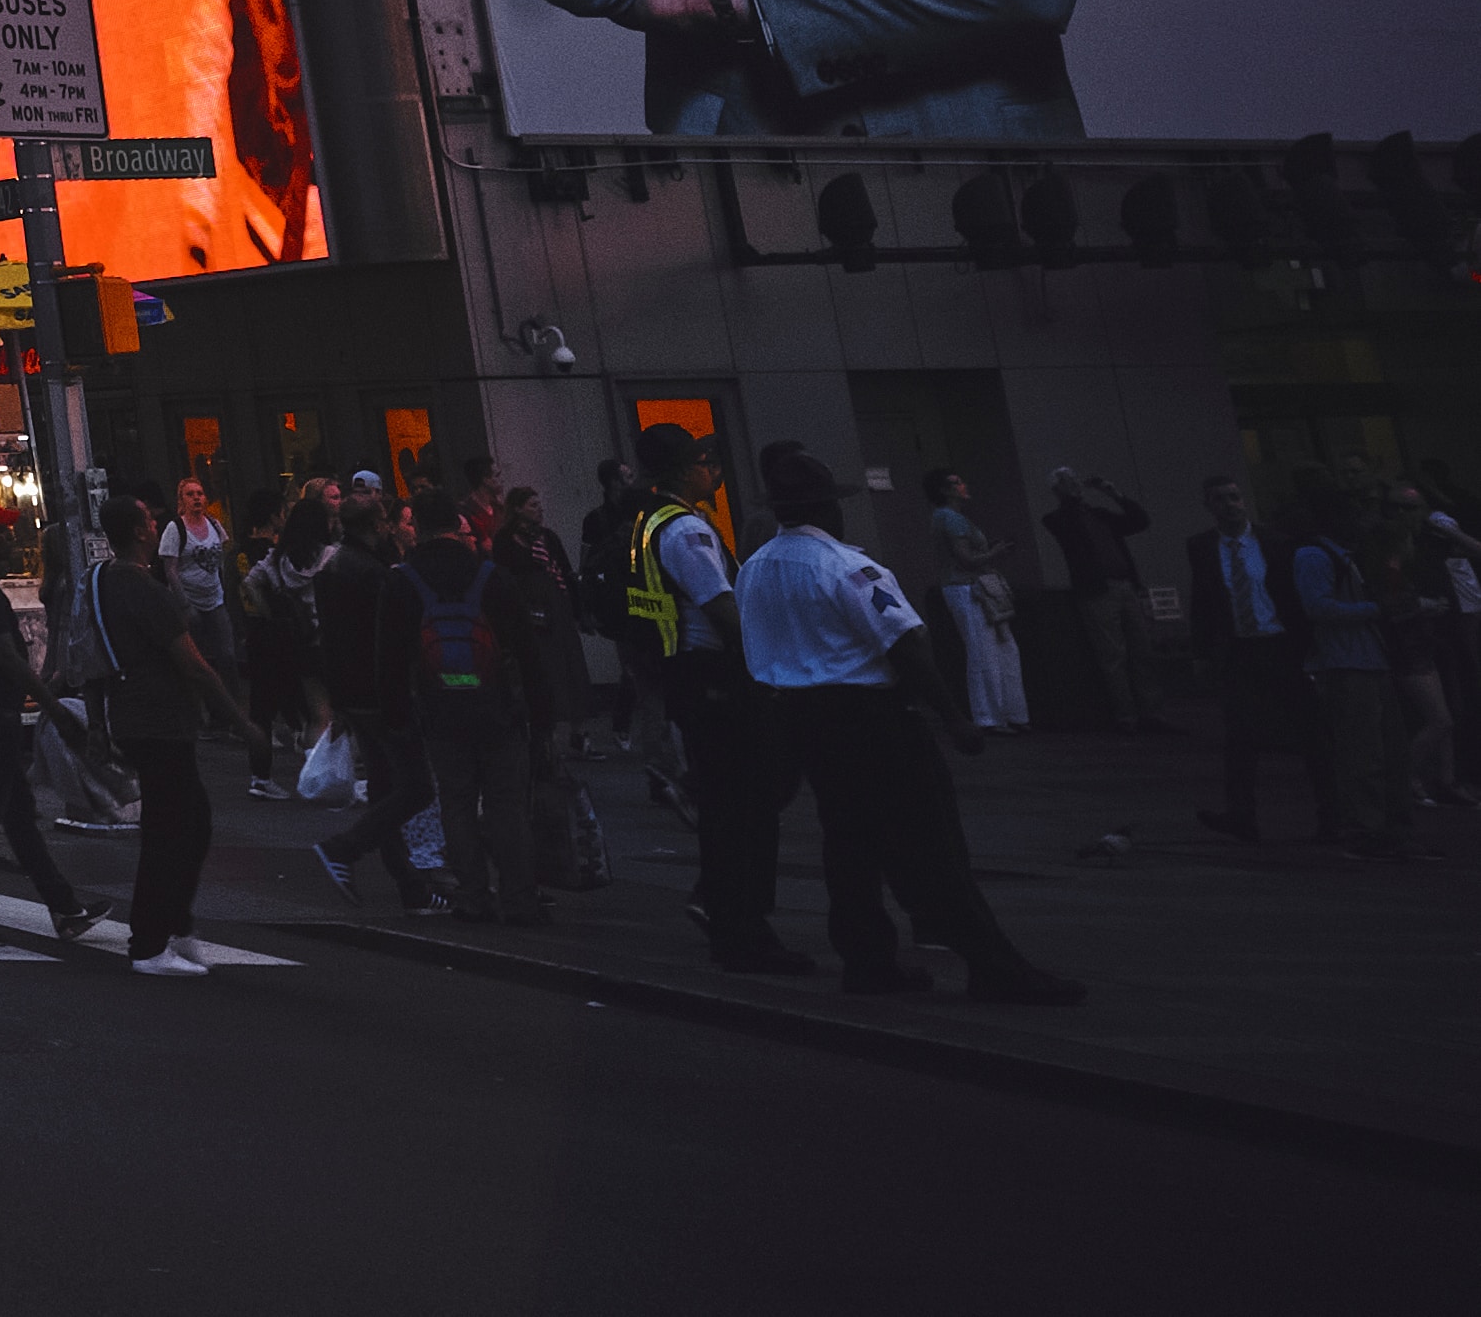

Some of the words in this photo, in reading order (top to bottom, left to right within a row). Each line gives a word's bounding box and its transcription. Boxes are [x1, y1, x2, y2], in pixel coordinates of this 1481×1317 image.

[2, 24, 60, 51] ONLY
[11, 105, 45, 123] MON
[47, 110, 74, 123] THRU
[75, 107, 99, 124] FRI
[89, 143, 206, 178] Broadway
